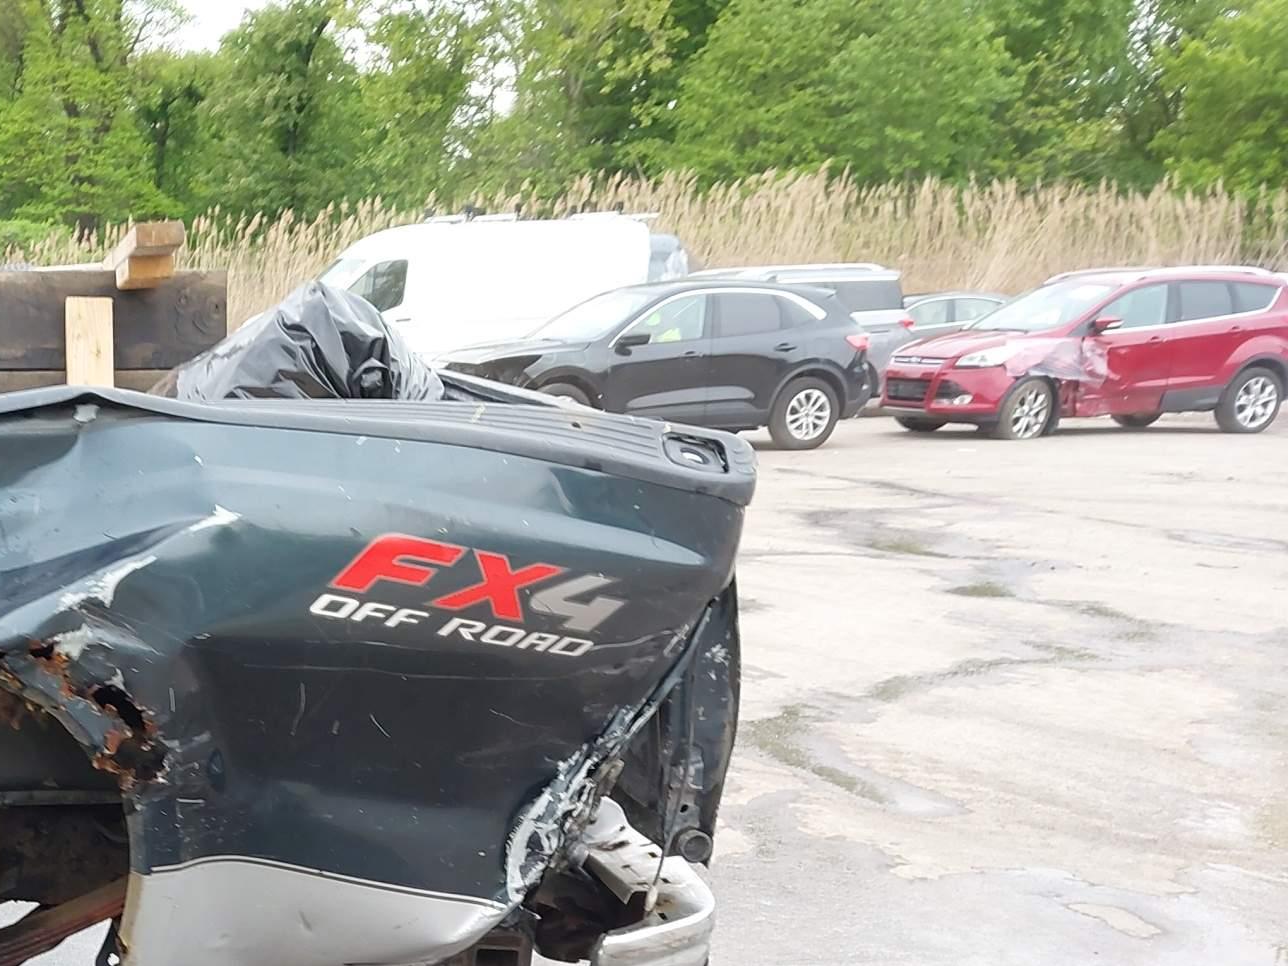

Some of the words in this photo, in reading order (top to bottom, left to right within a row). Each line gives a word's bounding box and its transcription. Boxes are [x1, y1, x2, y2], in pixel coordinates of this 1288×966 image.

[328, 532, 626, 632] FX4
[309, 593, 430, 627] OFF
[437, 616, 594, 657] ROAD
